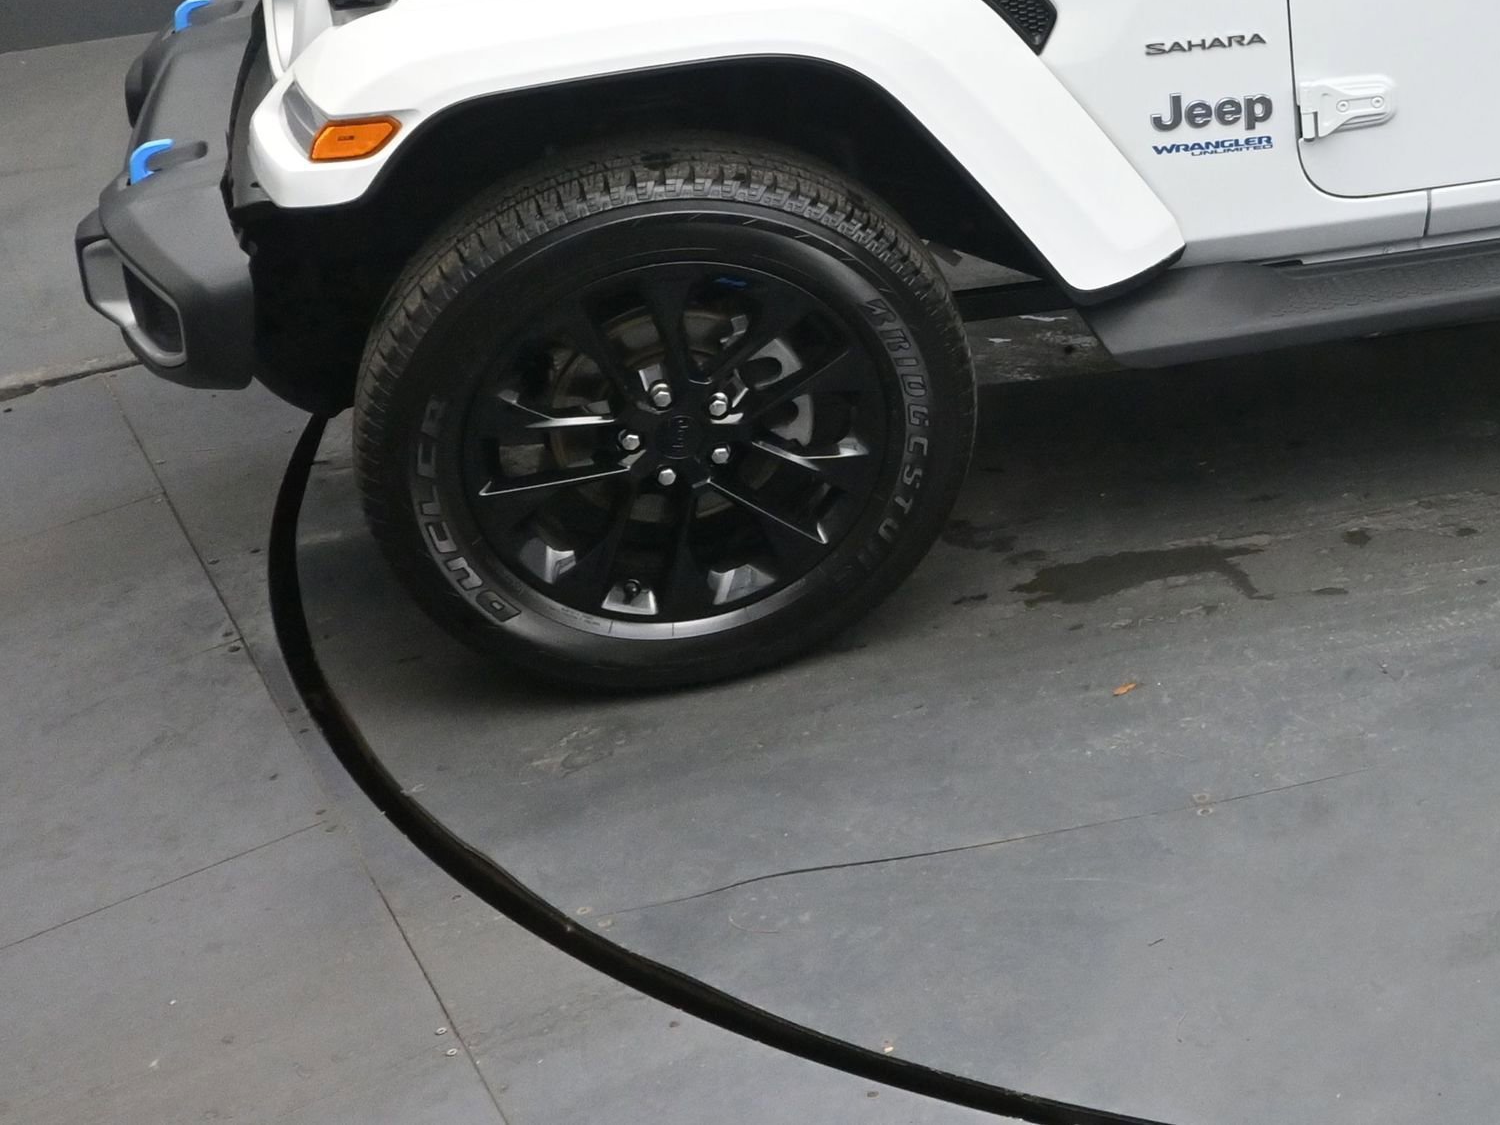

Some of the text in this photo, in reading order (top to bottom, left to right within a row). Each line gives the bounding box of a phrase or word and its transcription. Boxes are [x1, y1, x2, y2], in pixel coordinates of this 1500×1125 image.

[1145, 33, 1267, 56] SAHARA
[1150, 92, 1273, 132] Jeep
[1151, 135, 1273, 155] WRANGLER
[1190, 143, 1273, 157] UNLIMITED
[416, 394, 522, 623] DUELER
